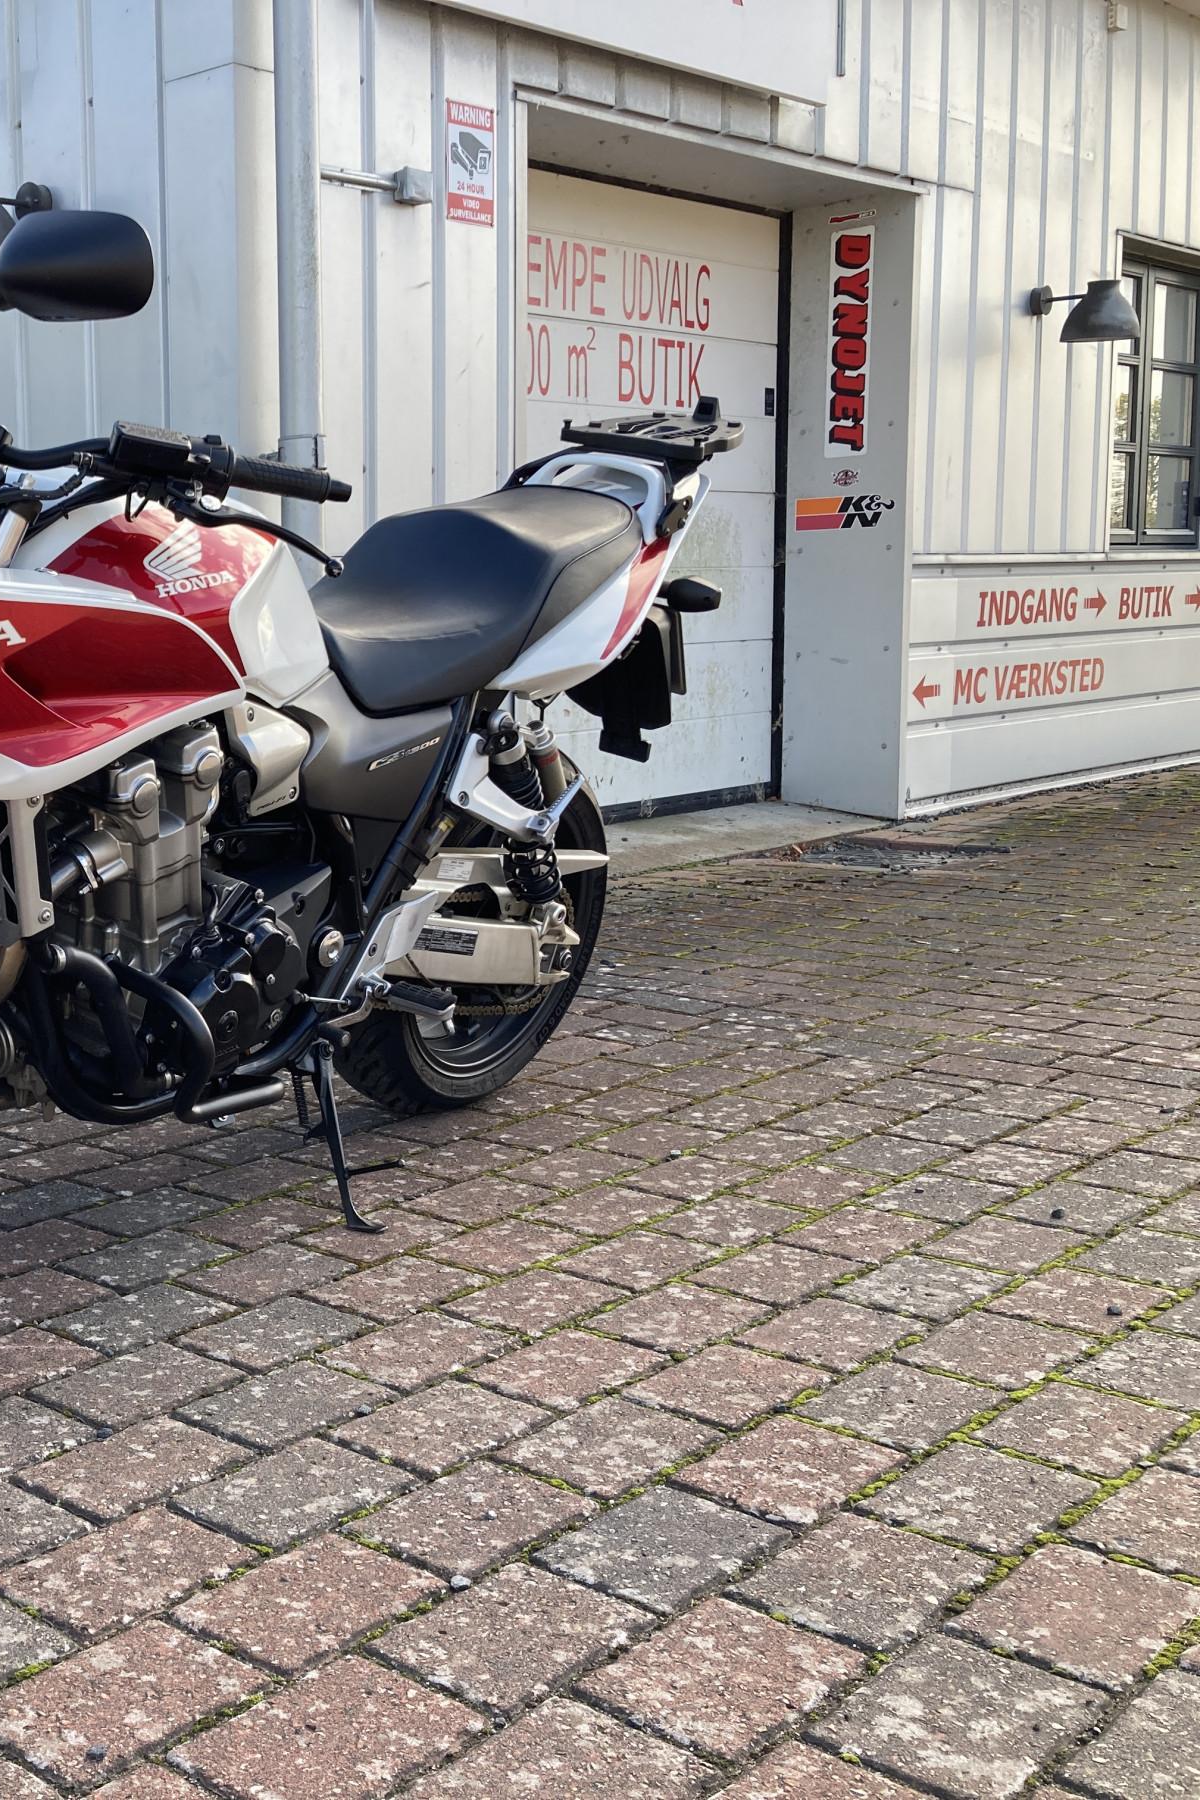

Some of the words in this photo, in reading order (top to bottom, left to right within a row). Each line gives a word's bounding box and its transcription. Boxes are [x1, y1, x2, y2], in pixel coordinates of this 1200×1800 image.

[450, 102, 491, 128] WARNING
[456, 181, 465, 191] 24
[467, 183, 485, 196] HOUR
[462, 198, 480, 209] VIDEO
[449, 207, 492, 223] SURVEILLANCE
[622, 250, 711, 332] UDVALG
[828, 233, 872, 452] DYNOJET
[618, 332, 705, 408] BUTIK
[156, 570, 237, 599] HONDA
[976, 586, 1079, 628] INDGANG
[1118, 585, 1175, 620] BUTIK
[953, 667, 989, 706] MC
[994, 657, 1105, 702] VÆRKSTED
